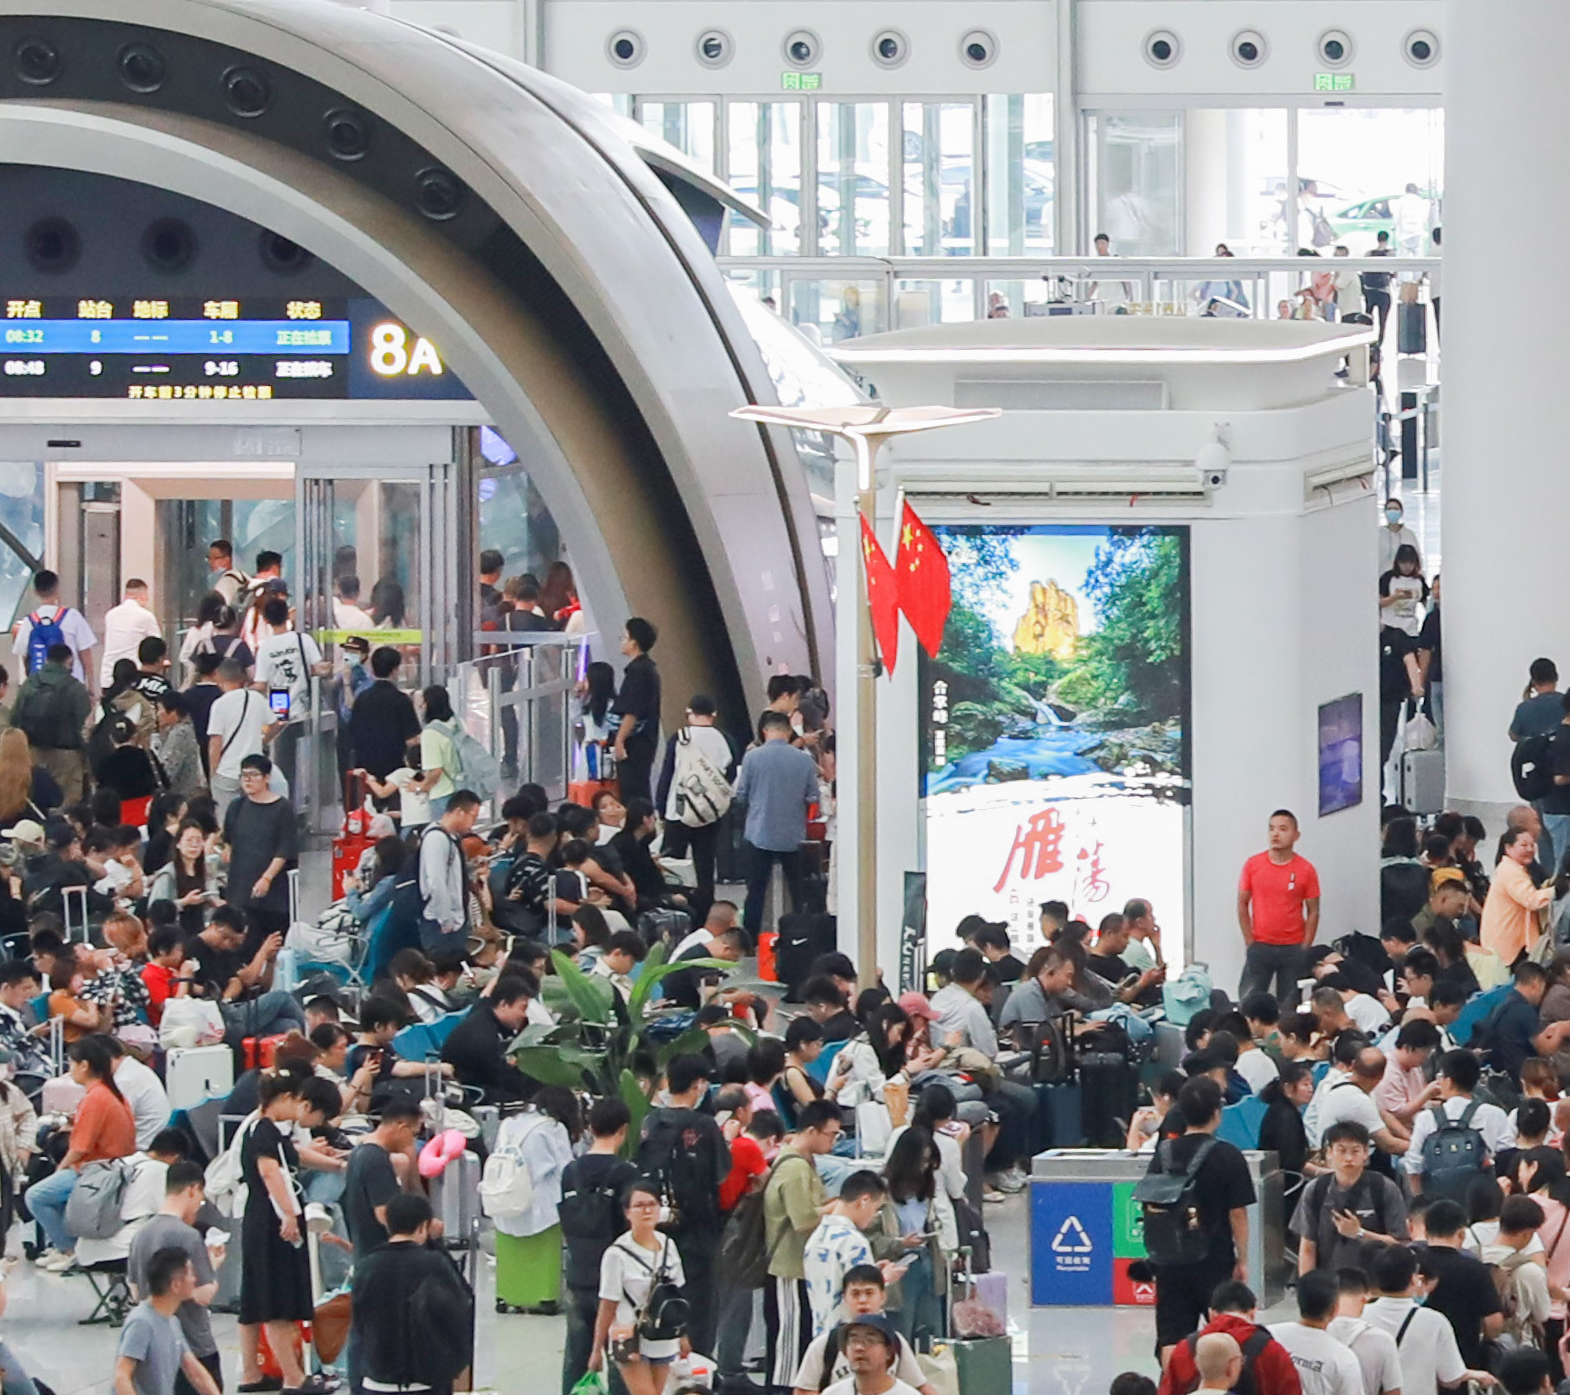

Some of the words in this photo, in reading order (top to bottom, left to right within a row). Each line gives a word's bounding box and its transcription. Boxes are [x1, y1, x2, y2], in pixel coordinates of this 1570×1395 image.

[7, 300, 41, 318] 开点
[287, 301, 321, 319] 状态
[371, 324, 441, 374] 8A
